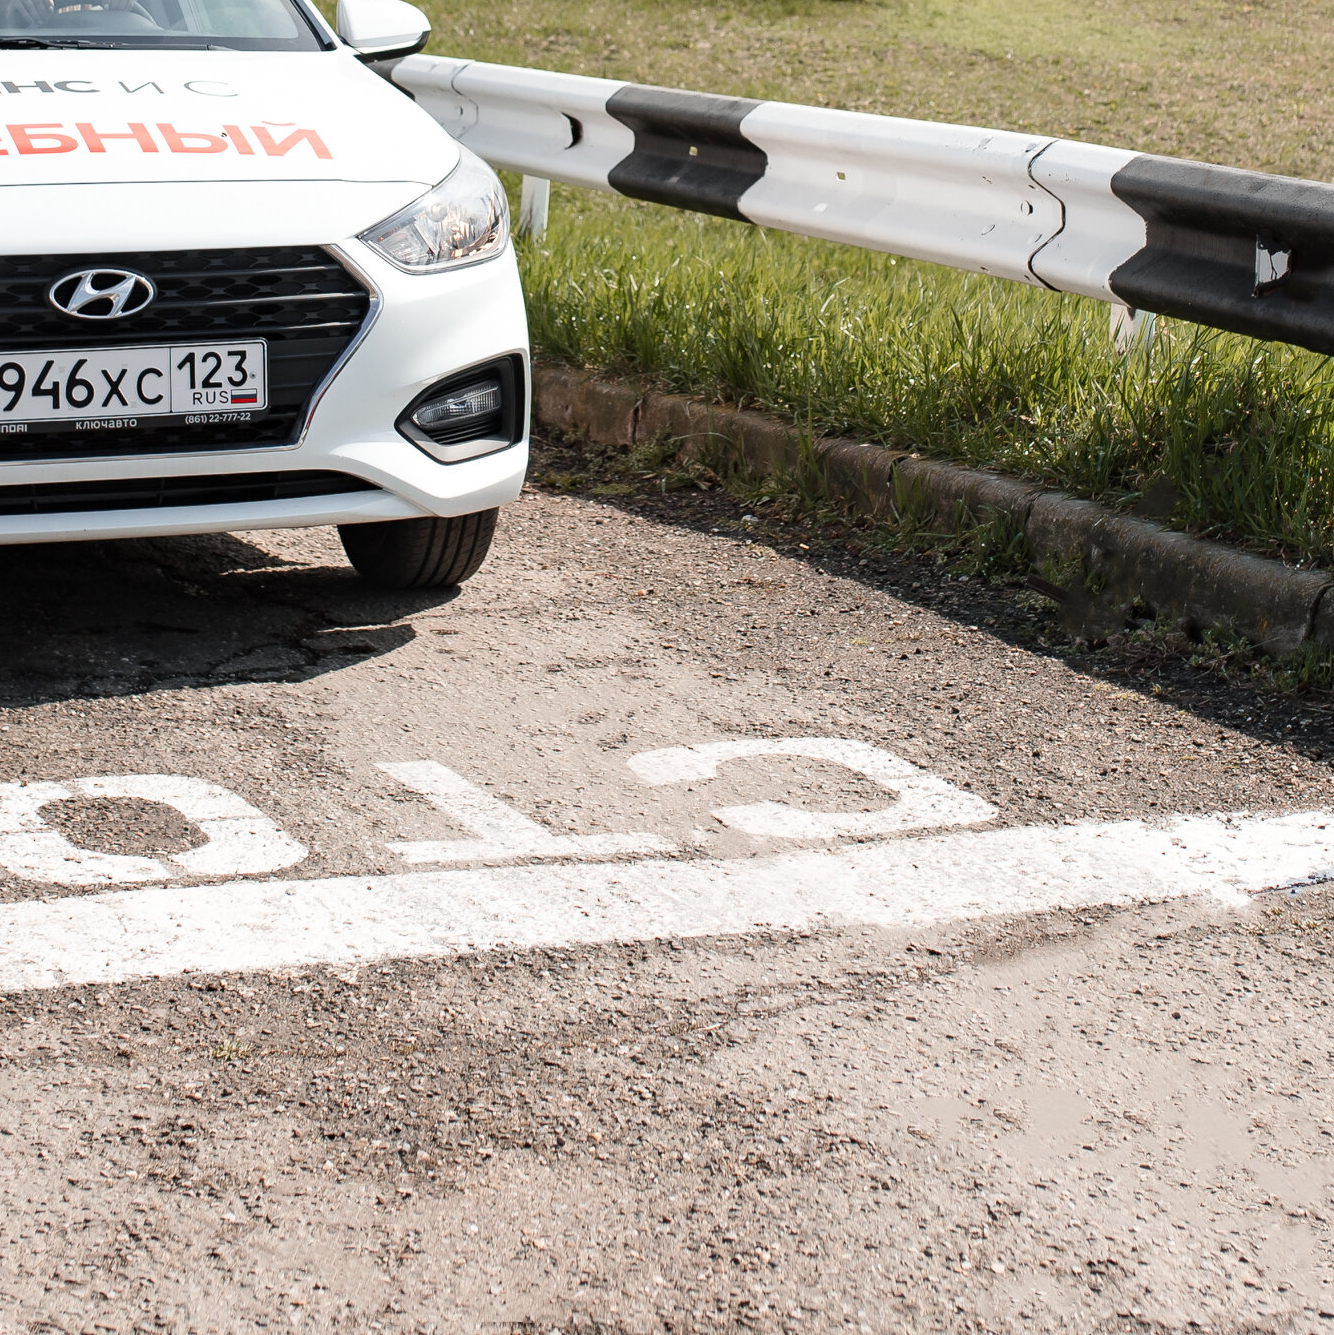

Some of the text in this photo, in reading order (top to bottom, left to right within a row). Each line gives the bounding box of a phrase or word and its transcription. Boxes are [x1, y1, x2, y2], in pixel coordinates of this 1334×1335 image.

[177, 350, 248, 390] 123
[193, 390, 229, 405] RUS
[185, 412, 251, 425] (861) 22-777-22
